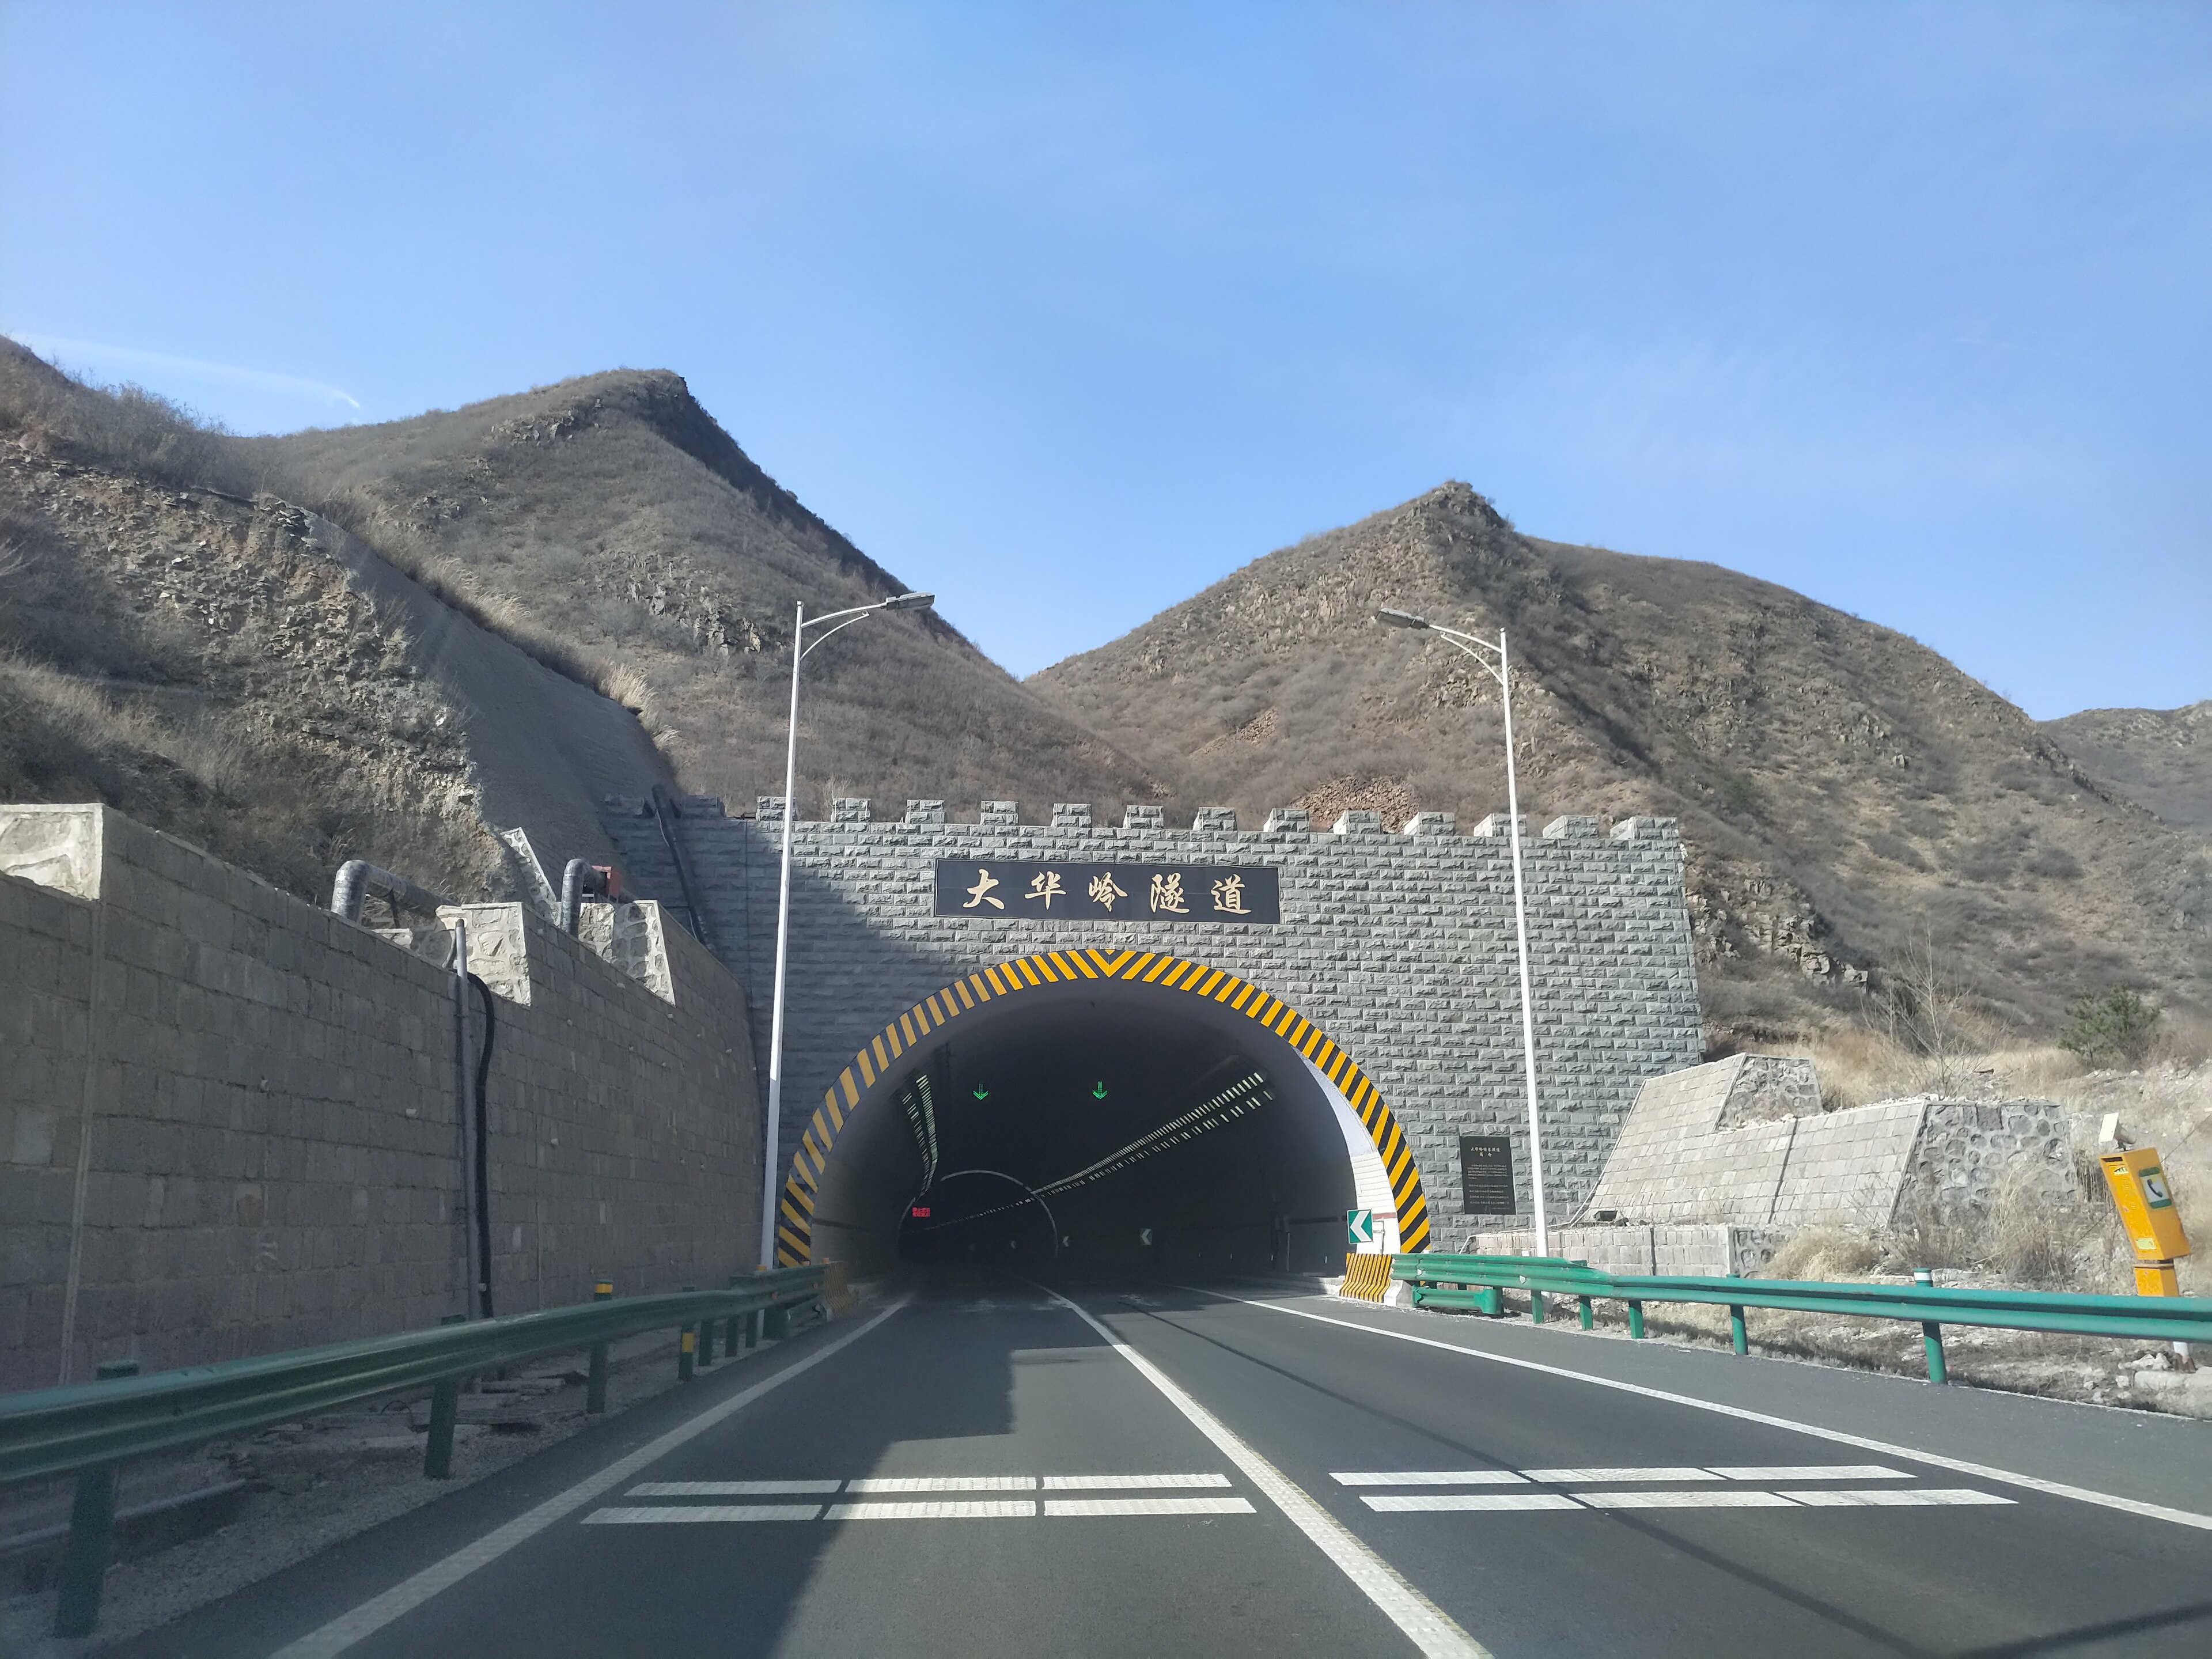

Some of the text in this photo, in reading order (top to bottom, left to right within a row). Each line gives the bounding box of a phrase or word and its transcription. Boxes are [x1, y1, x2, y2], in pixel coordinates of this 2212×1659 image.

[963, 869, 1252, 915] 大华岭隧道
